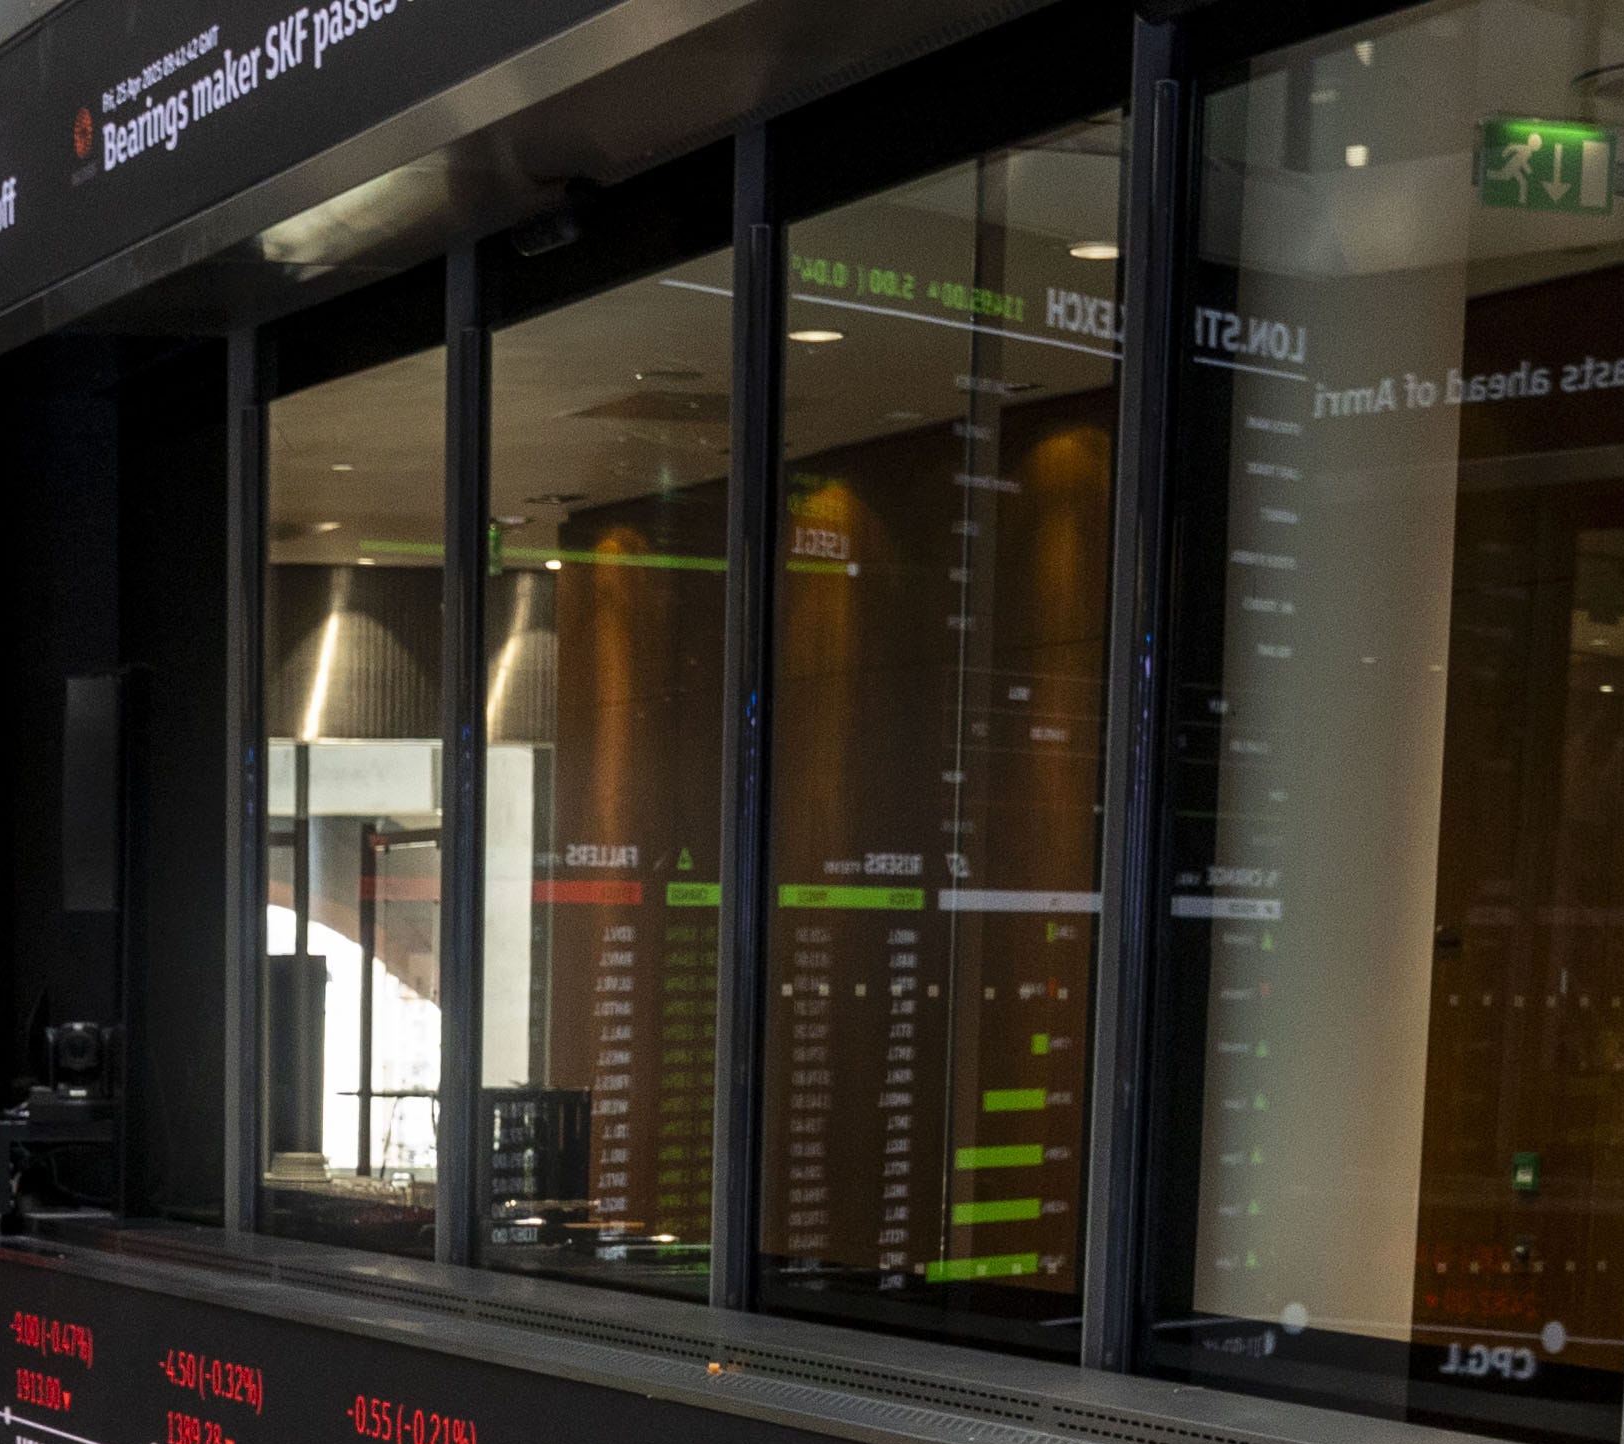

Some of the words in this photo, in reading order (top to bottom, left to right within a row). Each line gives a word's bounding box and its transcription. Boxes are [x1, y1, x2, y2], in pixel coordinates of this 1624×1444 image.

[102, 89, 189, 172] Bearings
[191, 46, 262, 122] maker
[265, 7, 309, 80] SKF
[158, 1349, 197, 1390] -4.50
[197, 1355, 264, 1415] (-0.32%)
[346, 1394, 393, 1442] -0.55
